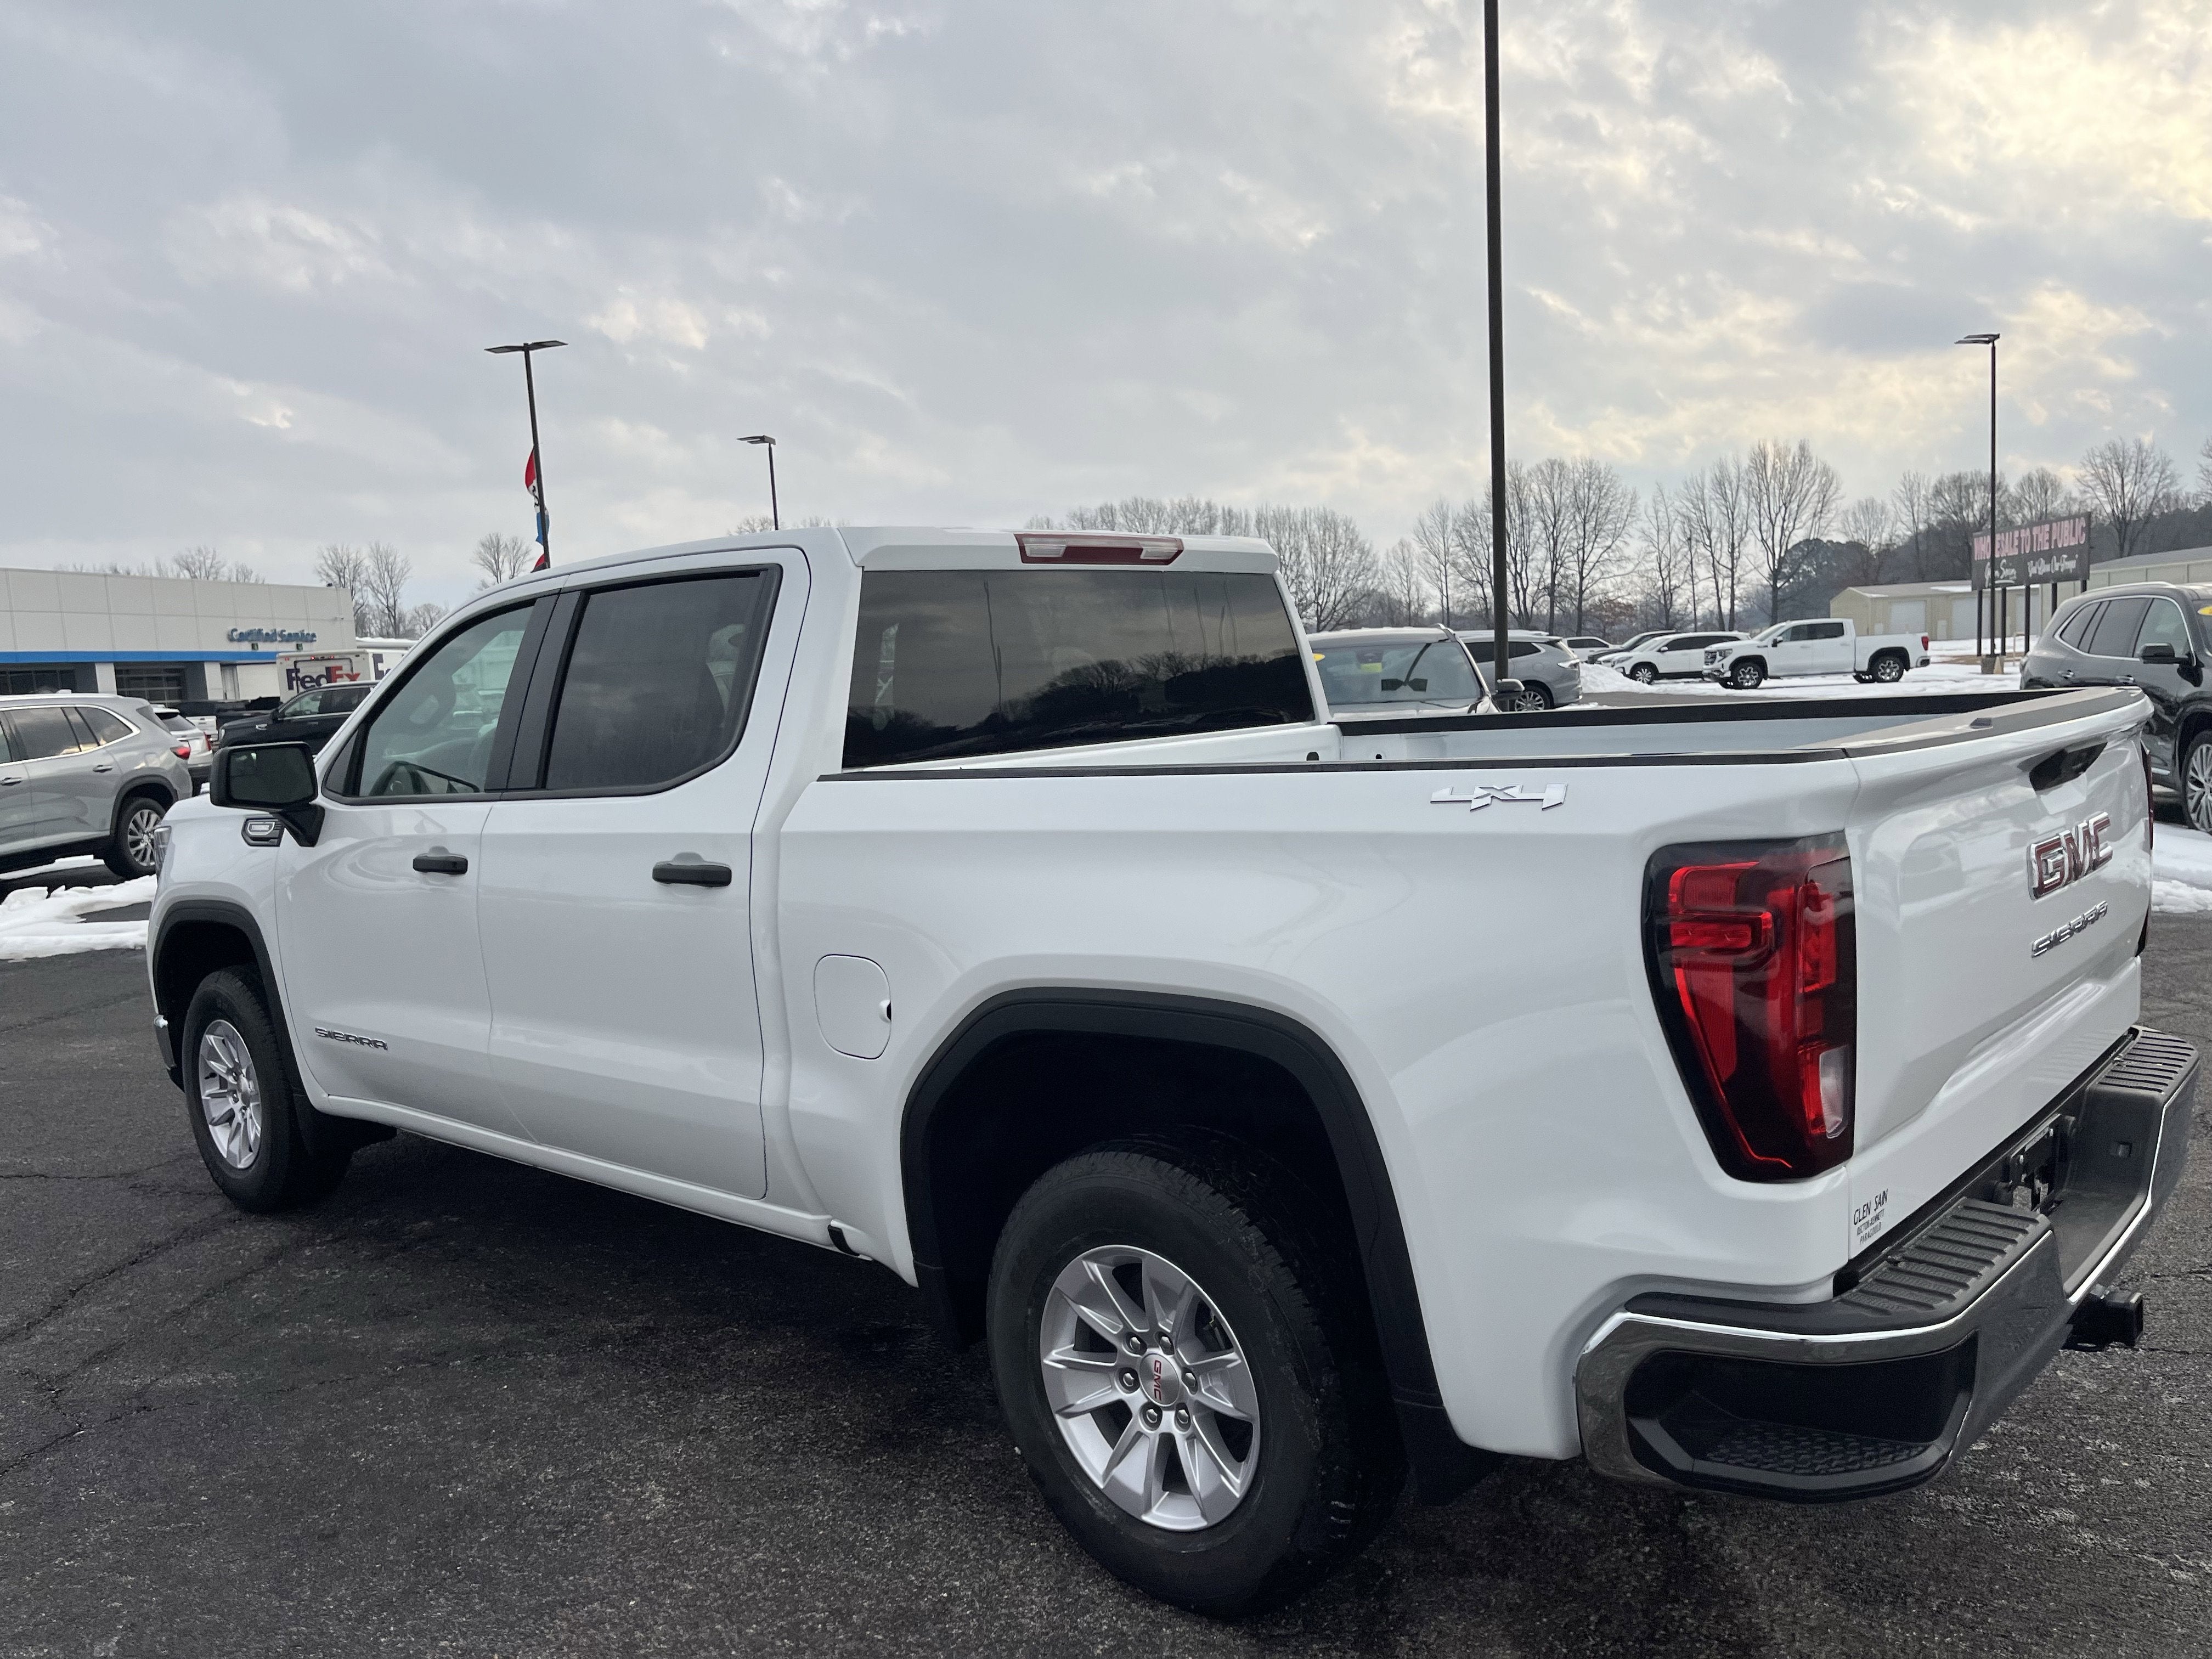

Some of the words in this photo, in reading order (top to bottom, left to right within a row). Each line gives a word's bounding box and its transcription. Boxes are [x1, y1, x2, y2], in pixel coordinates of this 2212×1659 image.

[1974, 530, 2019, 561] WHOESALE
[2021, 528, 2030, 554] TO
[2033, 524, 2050, 552] THE
[2051, 517, 2085, 549] PUBLIC
[2027, 812, 2113, 900] GMC
[2031, 900, 2108, 958] SIERRA
[315, 1026, 388, 1051] SIERRA
[1854, 1200, 1871, 1225] GLEN
